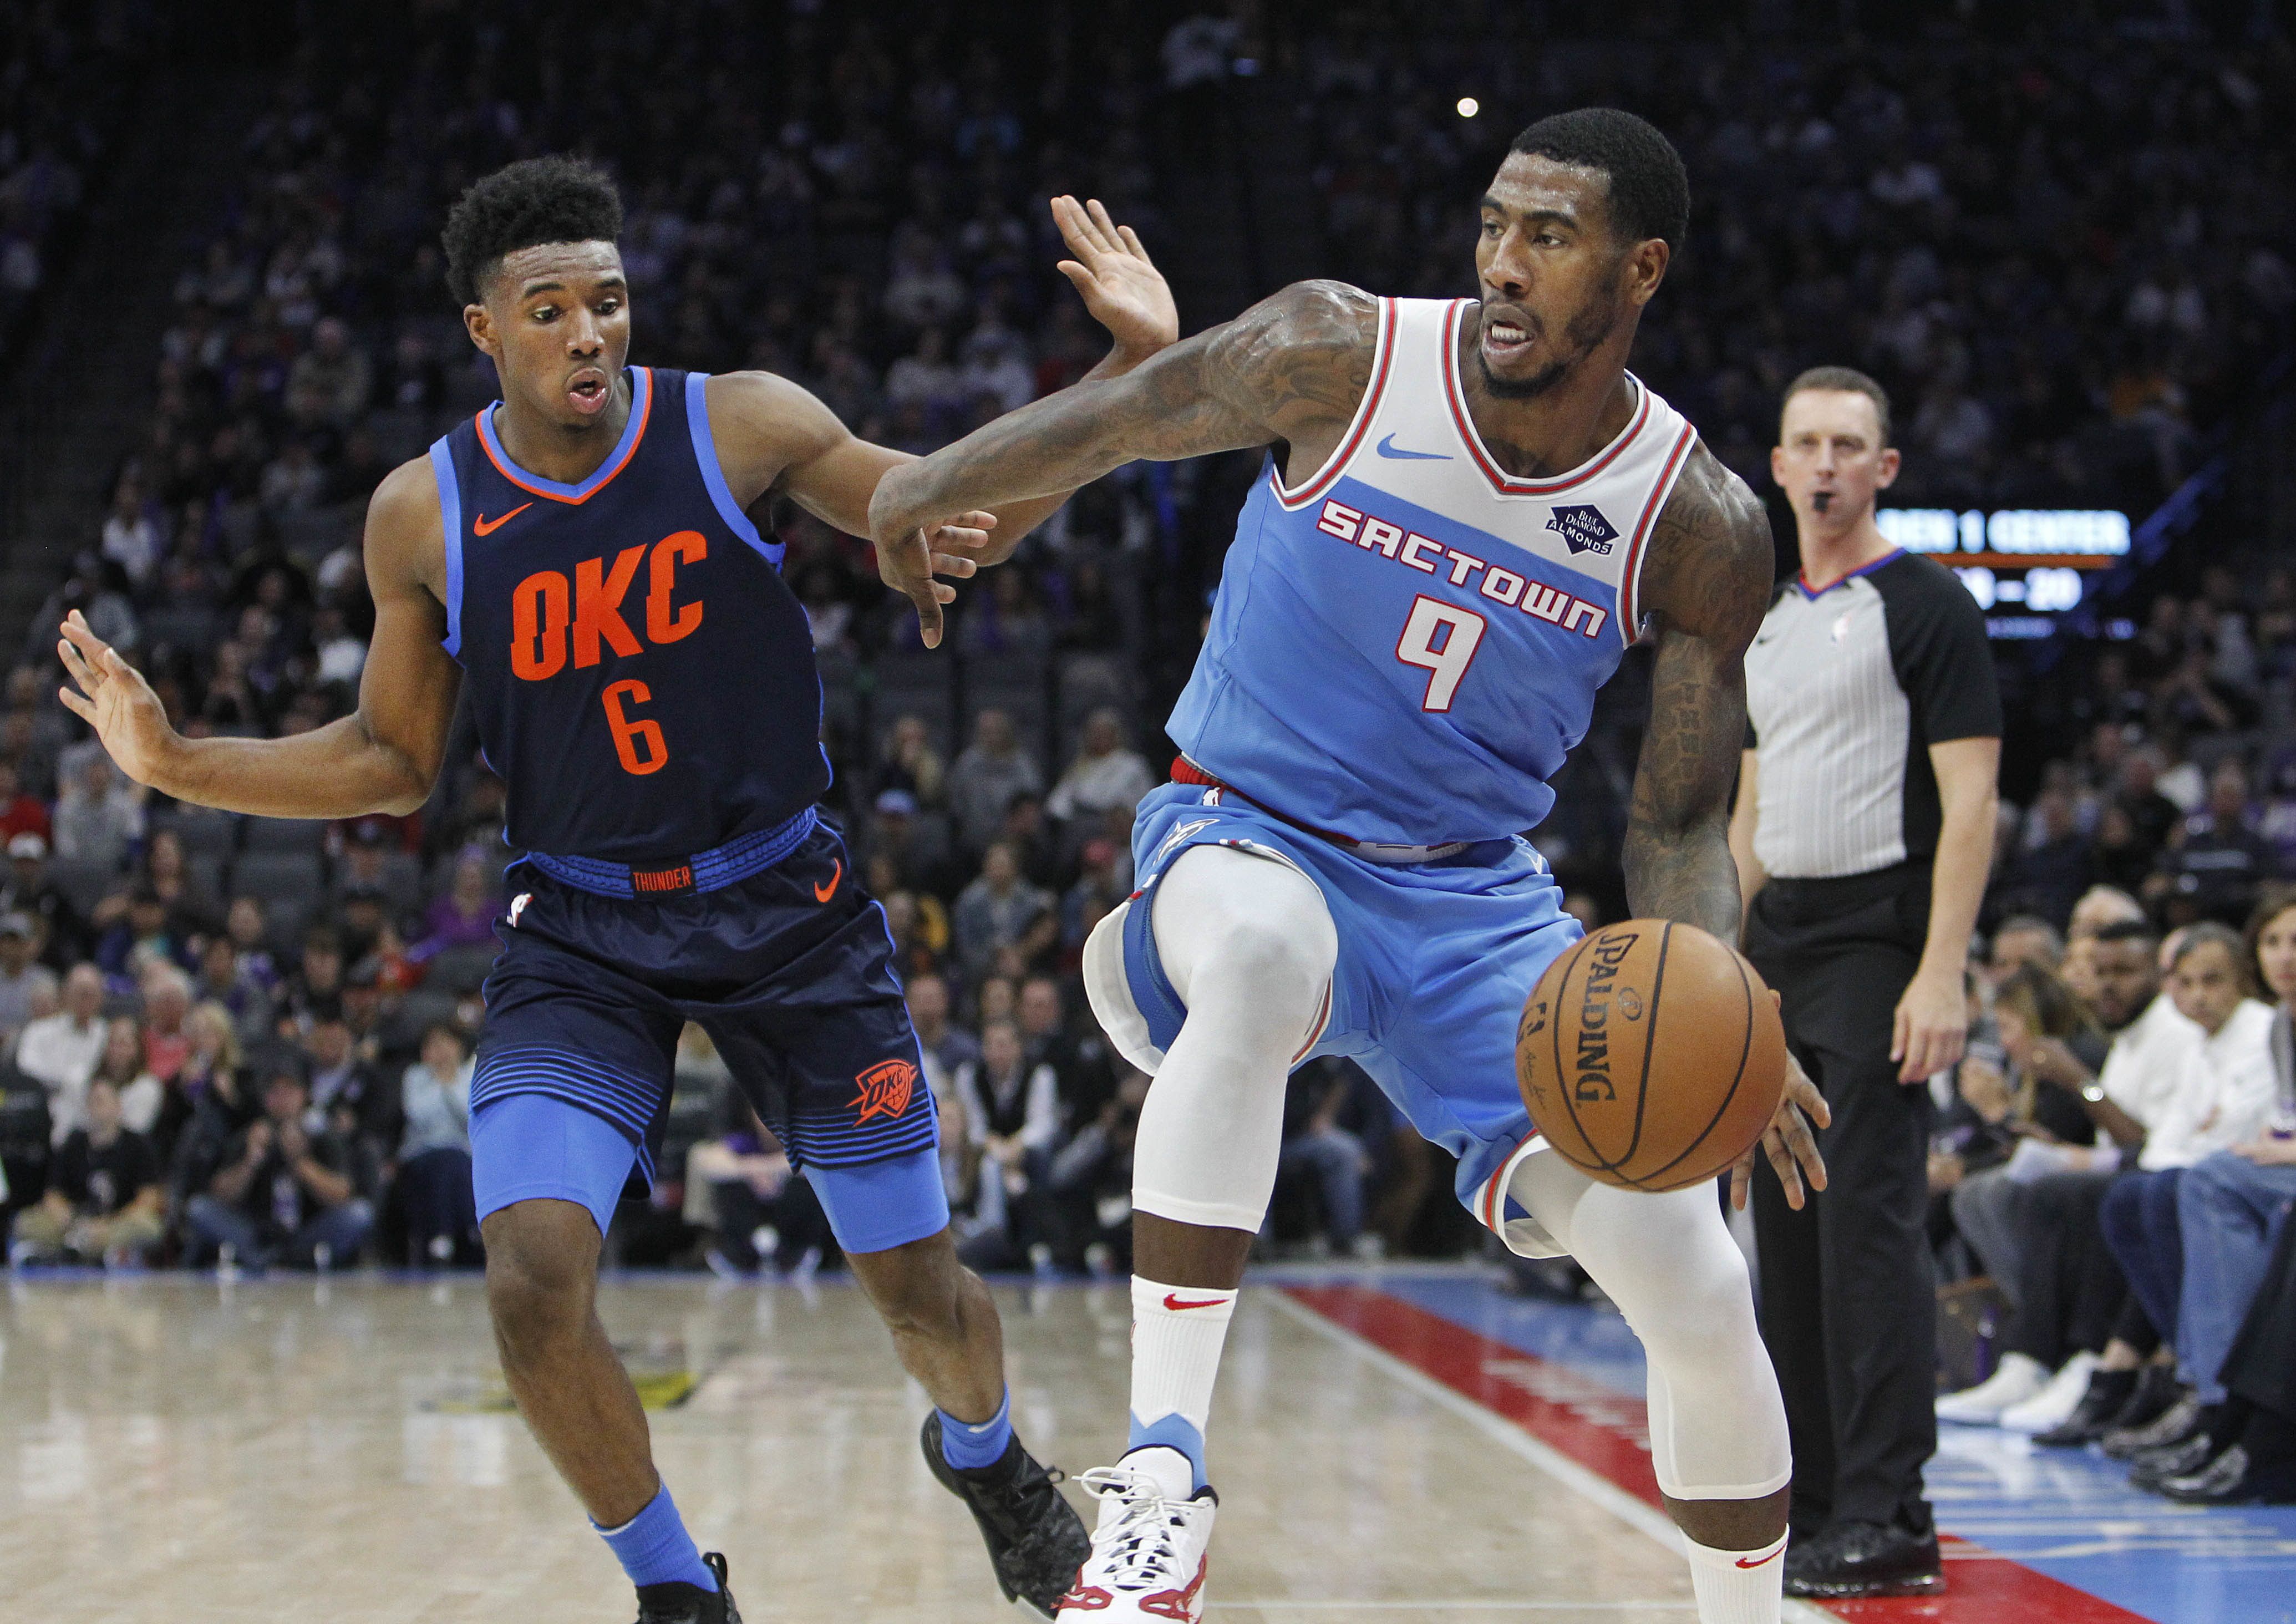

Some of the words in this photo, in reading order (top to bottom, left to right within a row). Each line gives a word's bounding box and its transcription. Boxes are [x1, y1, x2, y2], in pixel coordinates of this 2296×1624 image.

[1548, 520, 1609, 554] ALMONDS
[1565, 513, 1605, 536] DIAMOND
[1578, 510, 1599, 526] BLUE
[510, 530, 708, 681] OKC
[1317, 498, 1609, 639] SACTOWN
[1395, 592, 1488, 713] 9
[601, 678, 668, 775] 6
[632, 865, 691, 892] THUNDER
[1575, 933, 1639, 1103] SPALDING
